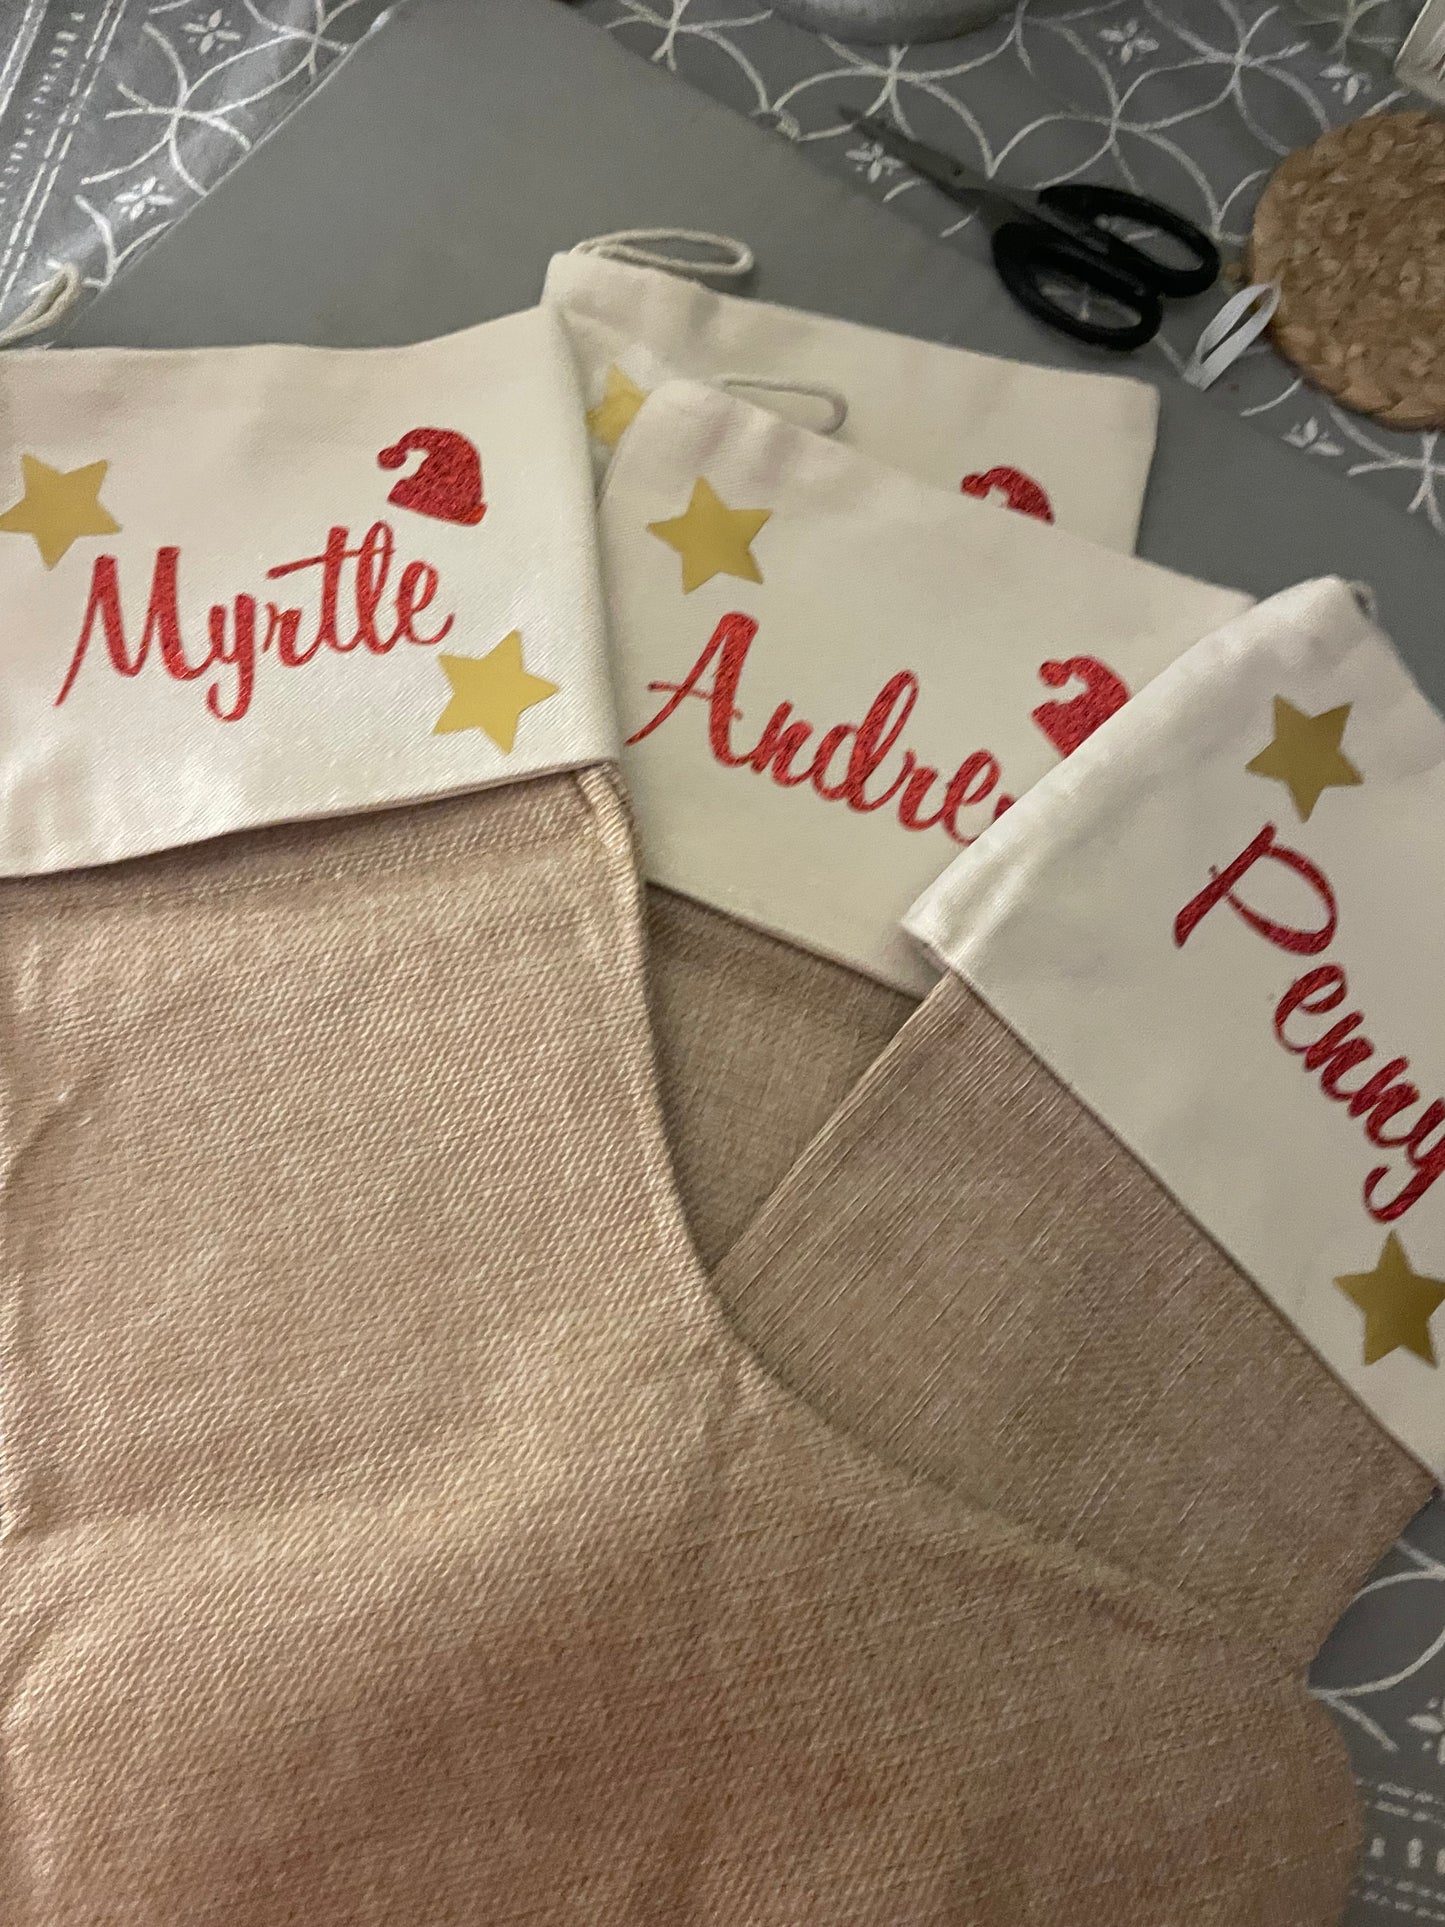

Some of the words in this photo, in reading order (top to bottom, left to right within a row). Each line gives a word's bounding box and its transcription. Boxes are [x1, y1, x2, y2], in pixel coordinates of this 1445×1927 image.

[54, 520, 456, 722] Myrtle
[625, 611, 1018, 847] Andre
[1173, 822, 1445, 1224] Penny
